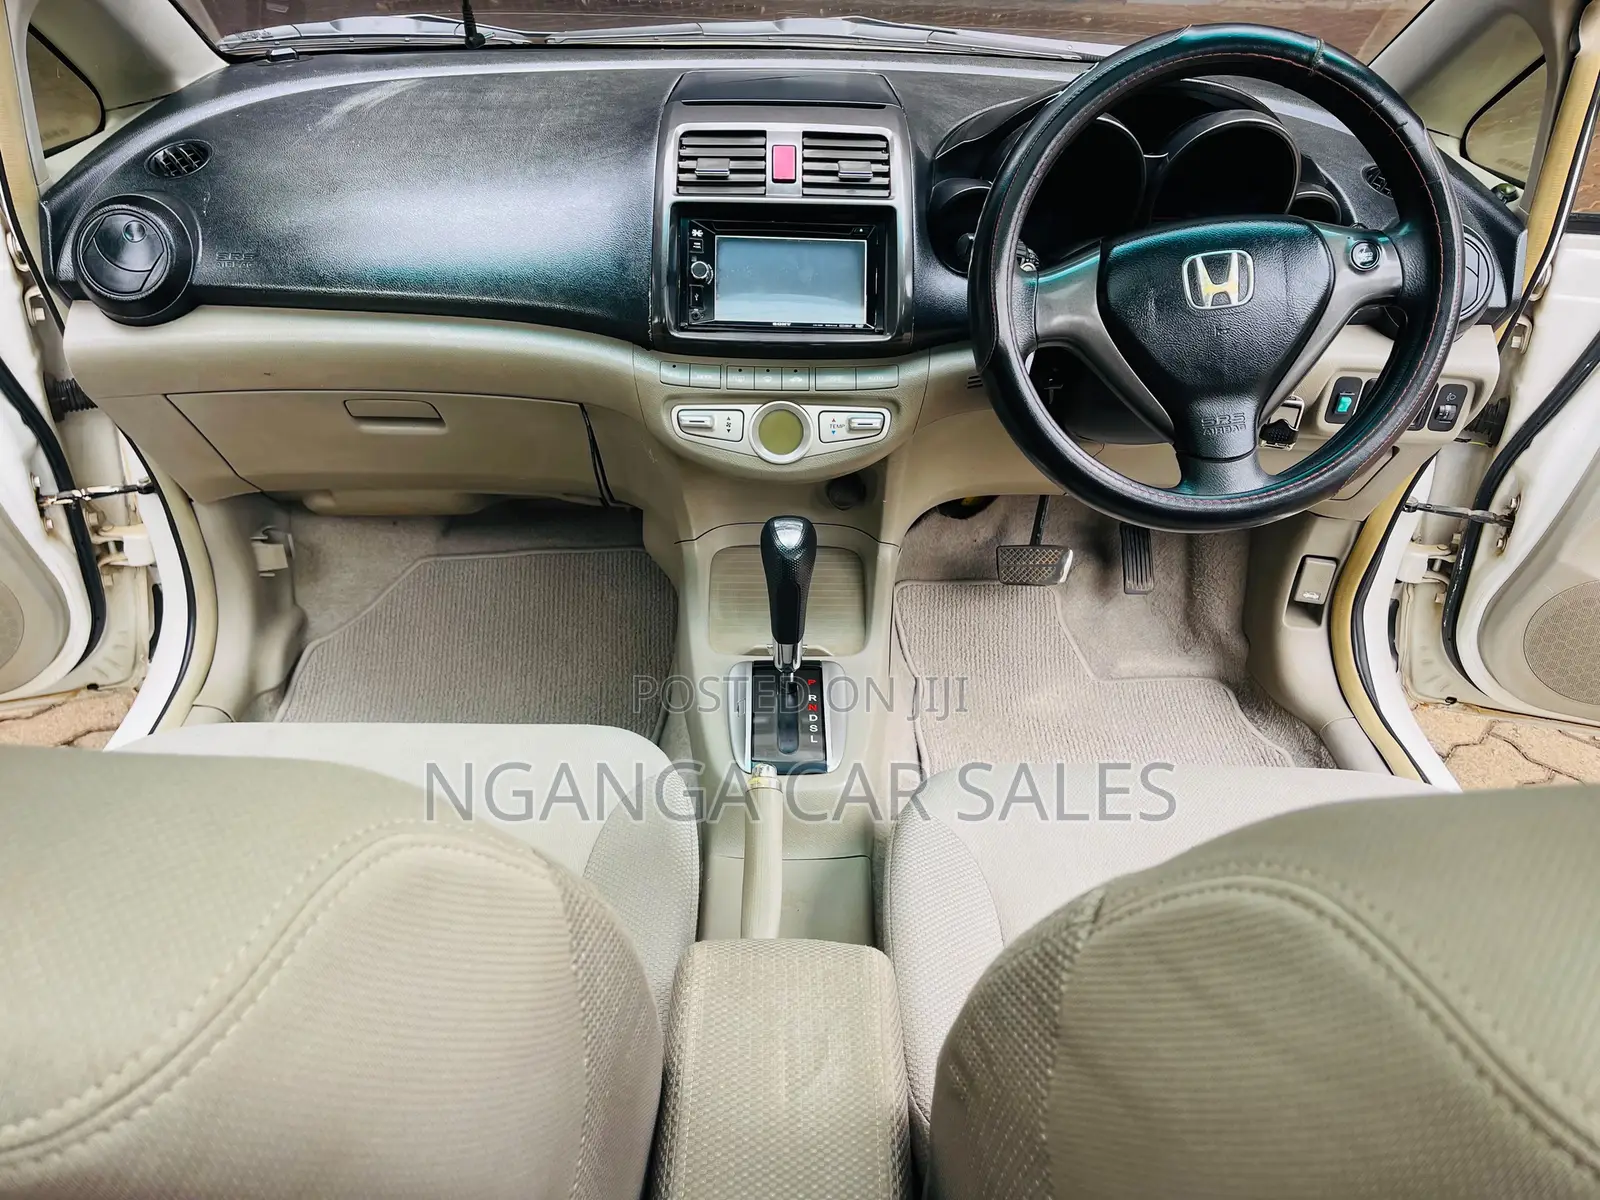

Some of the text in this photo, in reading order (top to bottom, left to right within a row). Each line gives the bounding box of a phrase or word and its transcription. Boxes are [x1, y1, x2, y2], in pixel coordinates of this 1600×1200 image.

[1202, 413, 1246, 428] SRS
[809, 714, 818, 722] D
[809, 724, 818, 732] S
[810, 735, 818, 743] L
